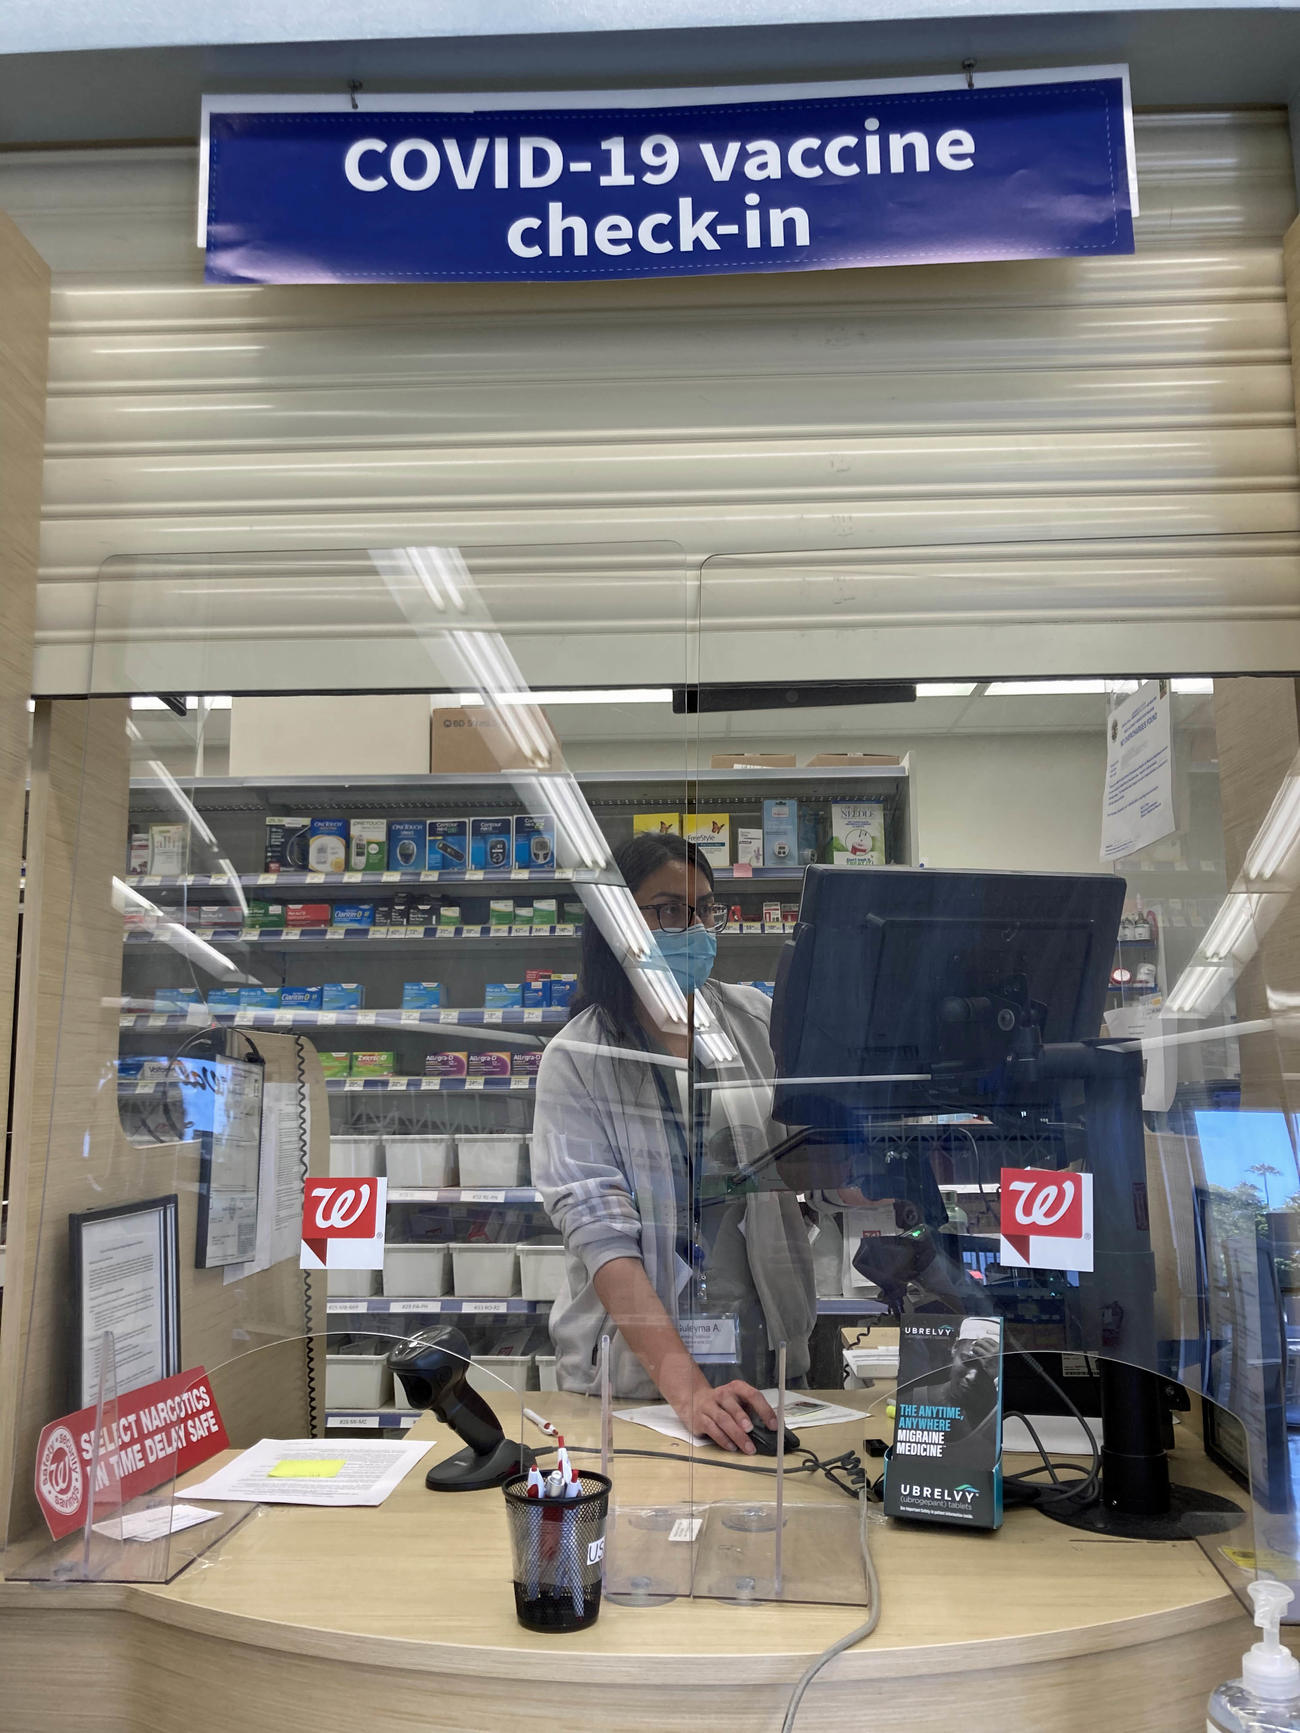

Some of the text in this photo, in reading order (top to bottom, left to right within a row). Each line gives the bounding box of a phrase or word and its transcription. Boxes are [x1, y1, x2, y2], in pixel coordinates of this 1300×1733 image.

[345, 118, 976, 192] COVID-19 vaccine
[507, 192, 810, 258] check-in
[311, 1184, 371, 1228] W
[1008, 1180, 1075, 1226] W
[905, 1327, 952, 1336] UBRELVY
[899, 1404, 964, 1420] THE ANYTIME,
[81, 1385, 211, 1460] SELECT NARCOTICS
[898, 1416, 951, 1431] ANYWHERE
[109, 1444, 145, 1481] TIME
[145, 1423, 187, 1463] DELAY
[187, 1410, 219, 1443] SAFE
[897, 1429, 945, 1444] MIGRAINE
[896, 1442, 943, 1457] MEDICINE
[900, 1495, 973, 1511] (ubrogepant) tablets
[901, 1483, 975, 1503] UBRELVY
